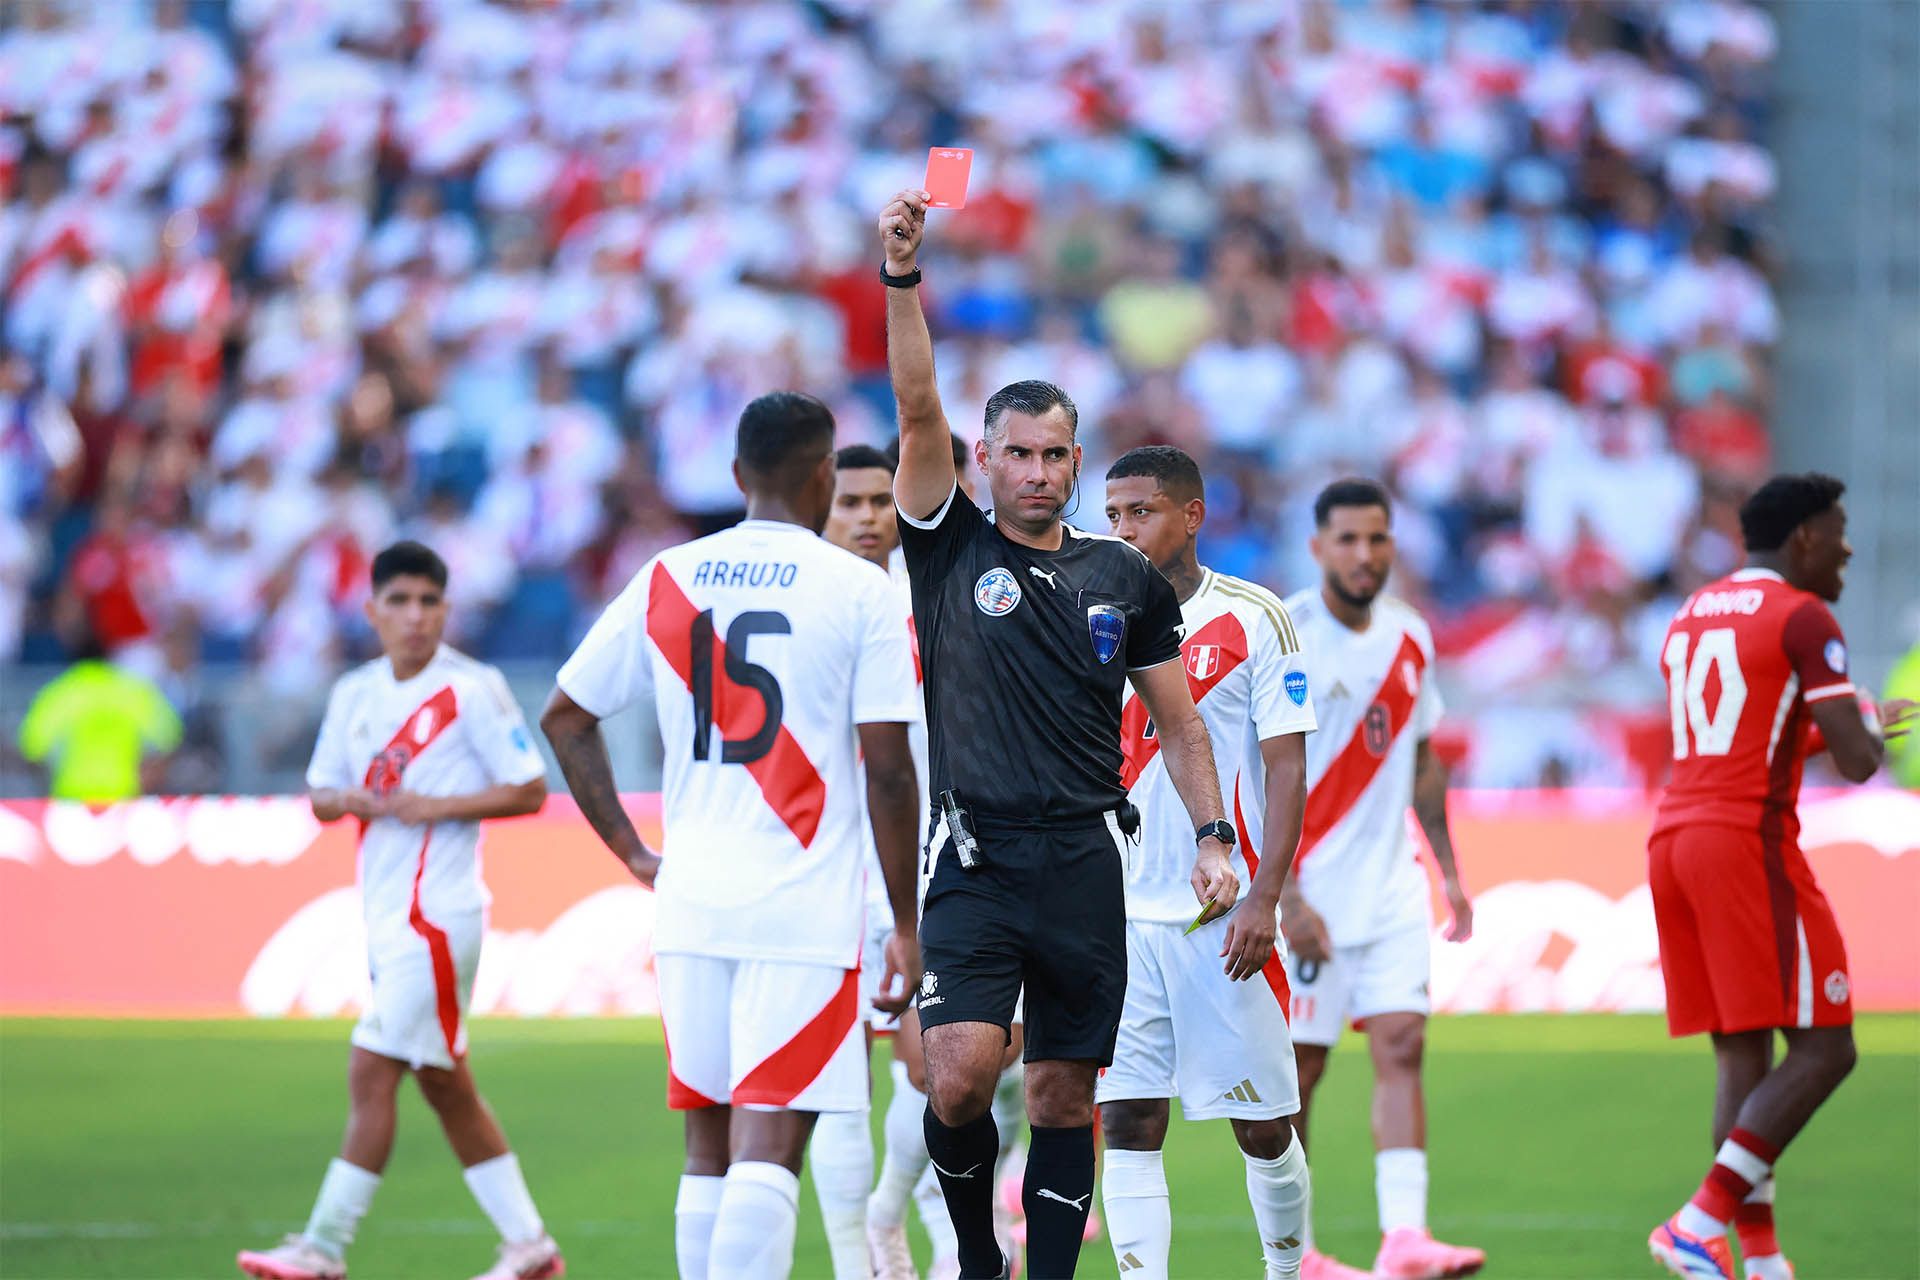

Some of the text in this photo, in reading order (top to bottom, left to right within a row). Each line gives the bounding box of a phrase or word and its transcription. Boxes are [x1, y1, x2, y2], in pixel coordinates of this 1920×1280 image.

[694, 561, 798, 587] ARAUJO
[1692, 588, 1764, 617] DAVID
[690, 608, 792, 764] 15
[1664, 627, 1748, 761] 10
[1365, 704, 1390, 755] 8
